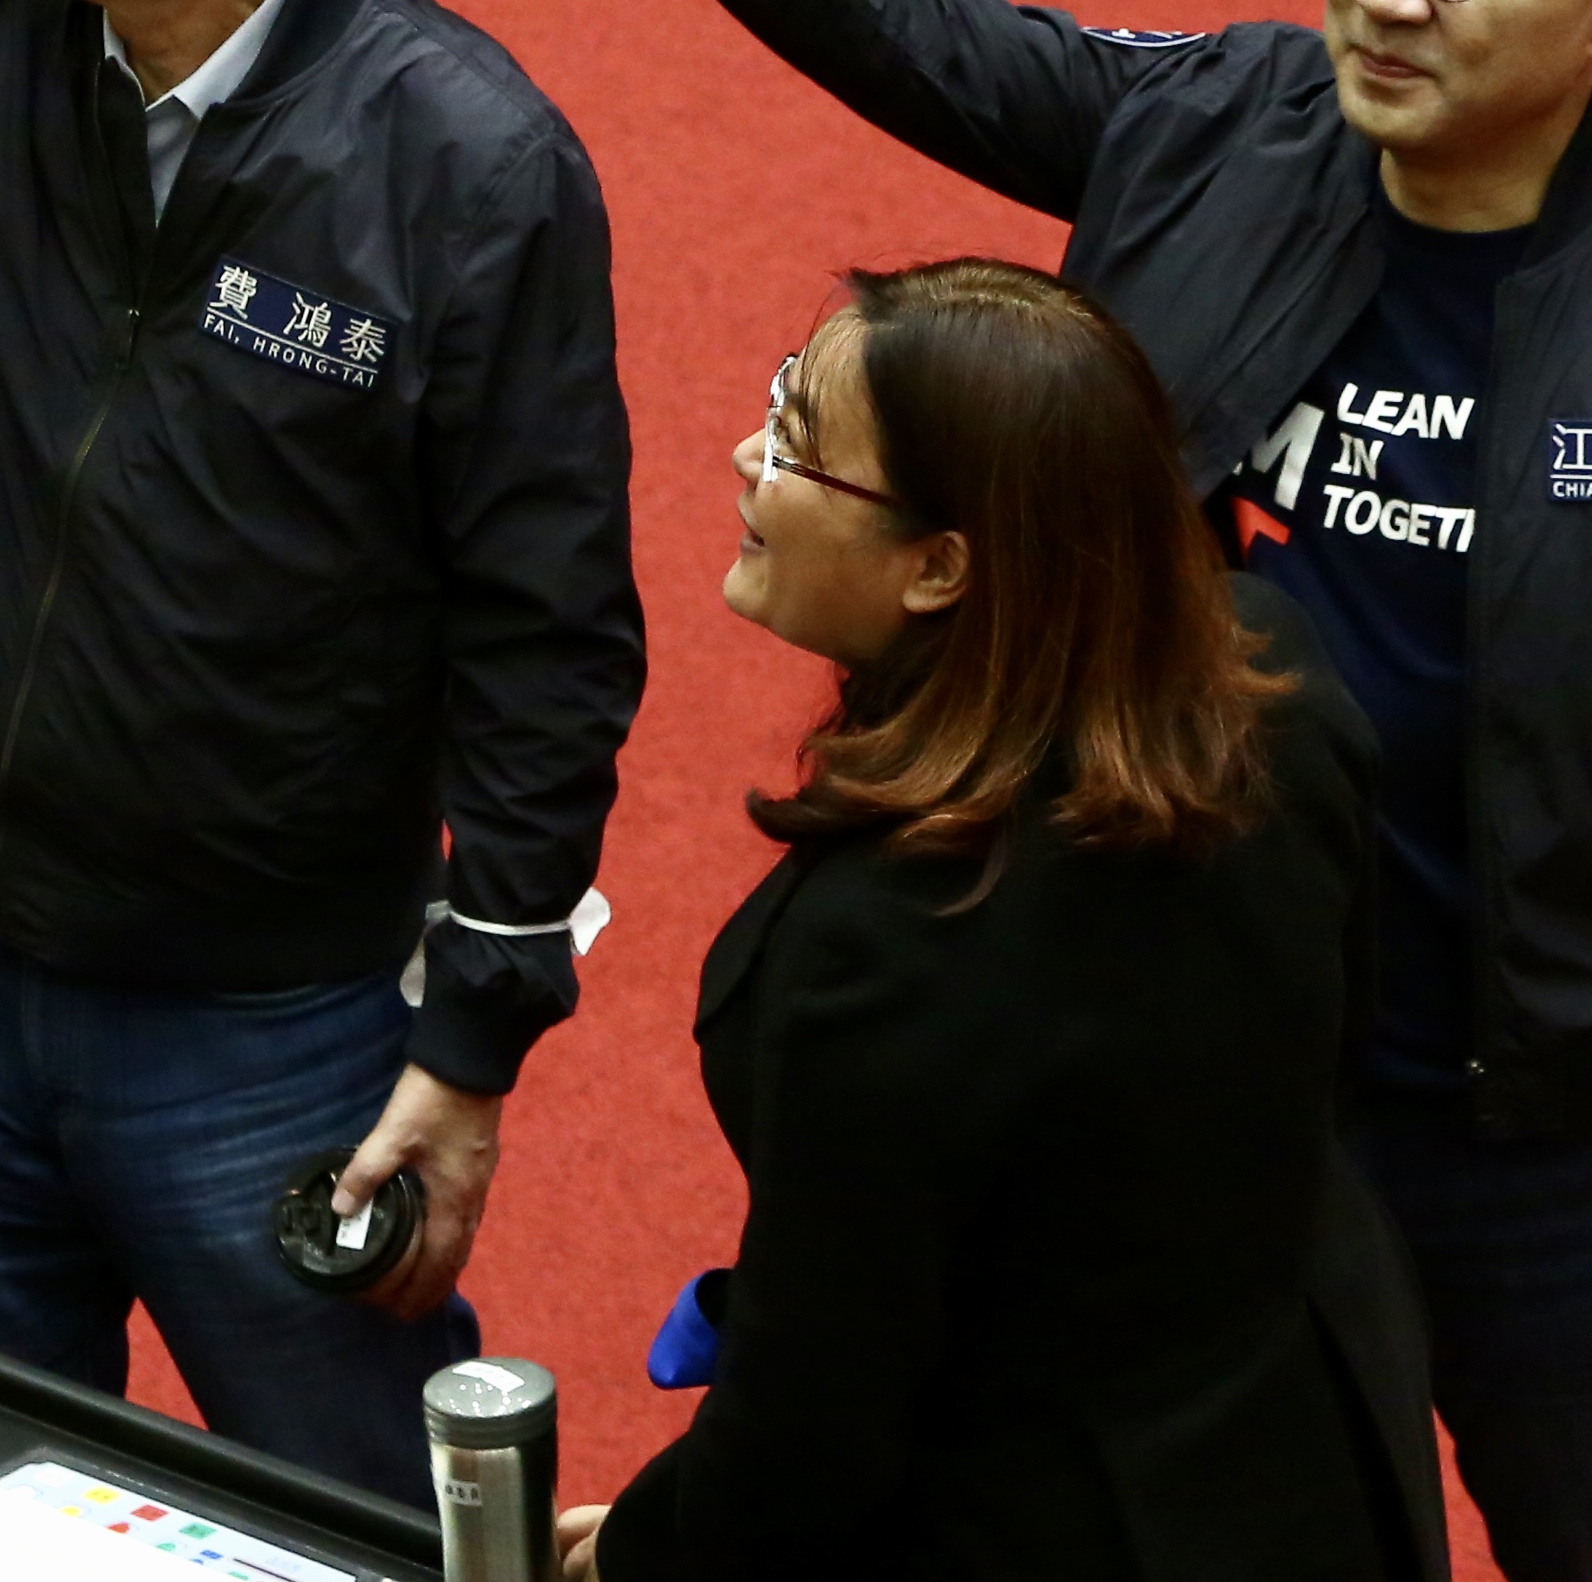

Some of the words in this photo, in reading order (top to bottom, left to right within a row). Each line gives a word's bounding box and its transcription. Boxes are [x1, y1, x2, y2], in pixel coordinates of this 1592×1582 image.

[209, 265, 386, 363] 費鴻泰
[204, 313, 240, 345] FAI,
[253, 335, 375, 388] HRONG-TAI
[1337, 382, 1475, 440] LEAN
[1331, 432, 1384, 481] IN
